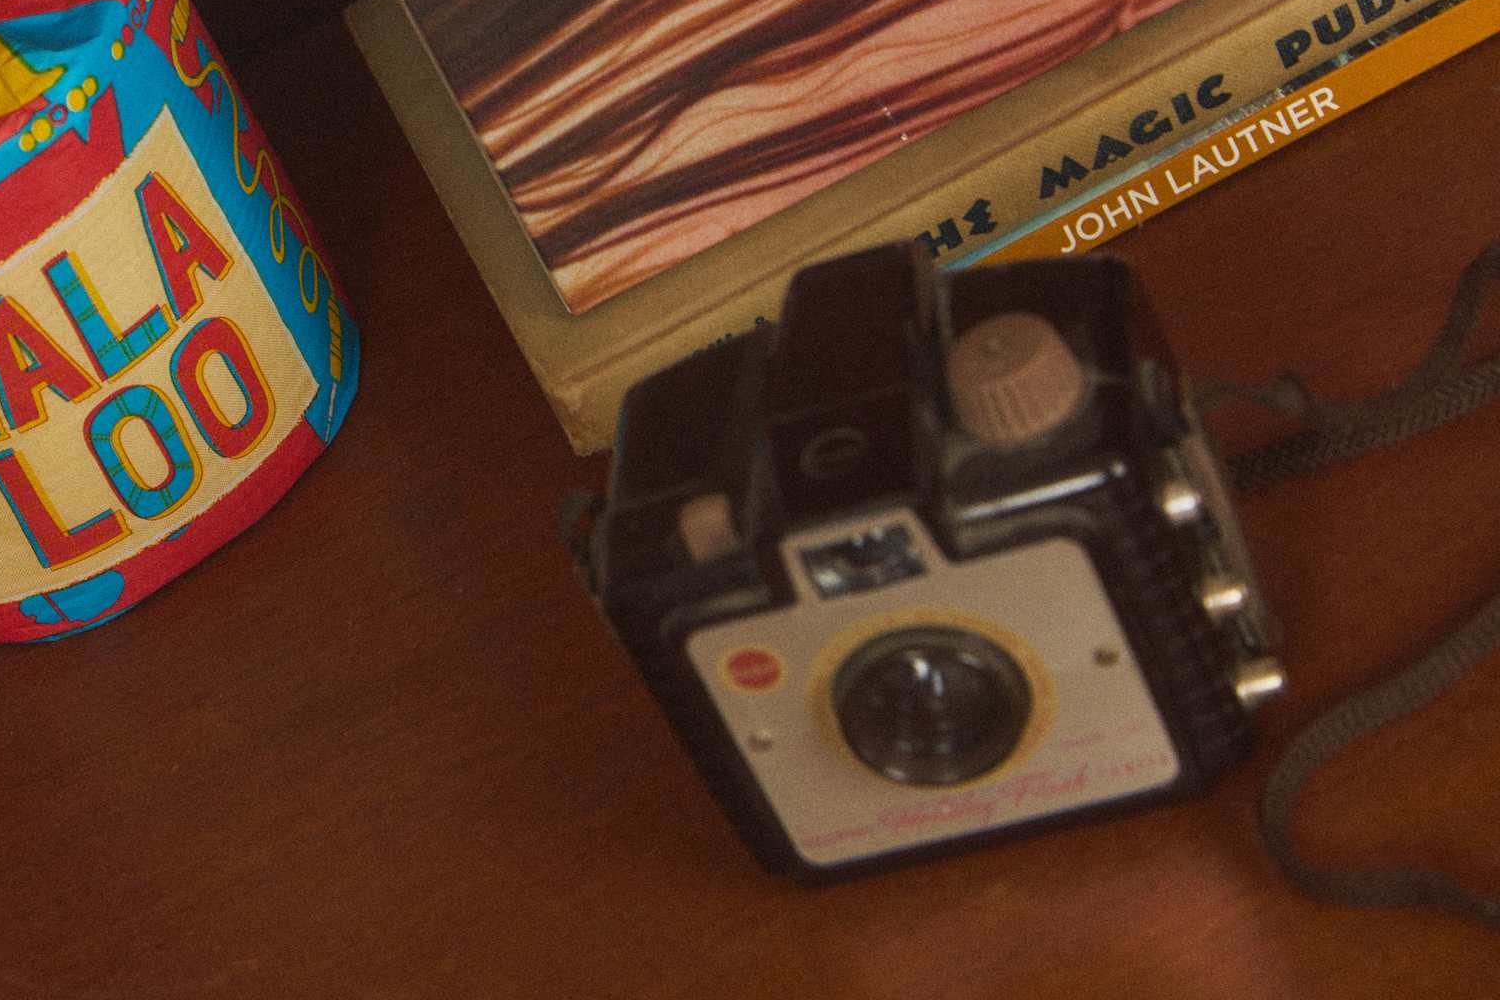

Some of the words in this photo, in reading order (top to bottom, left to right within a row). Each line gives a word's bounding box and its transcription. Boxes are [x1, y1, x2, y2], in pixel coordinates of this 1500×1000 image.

[914, 199, 999, 259] HE
[1038, 73, 1233, 200] MAGIC
[1060, 180, 1160, 254] JOHN
[1164, 86, 1341, 196] LAUTNER
